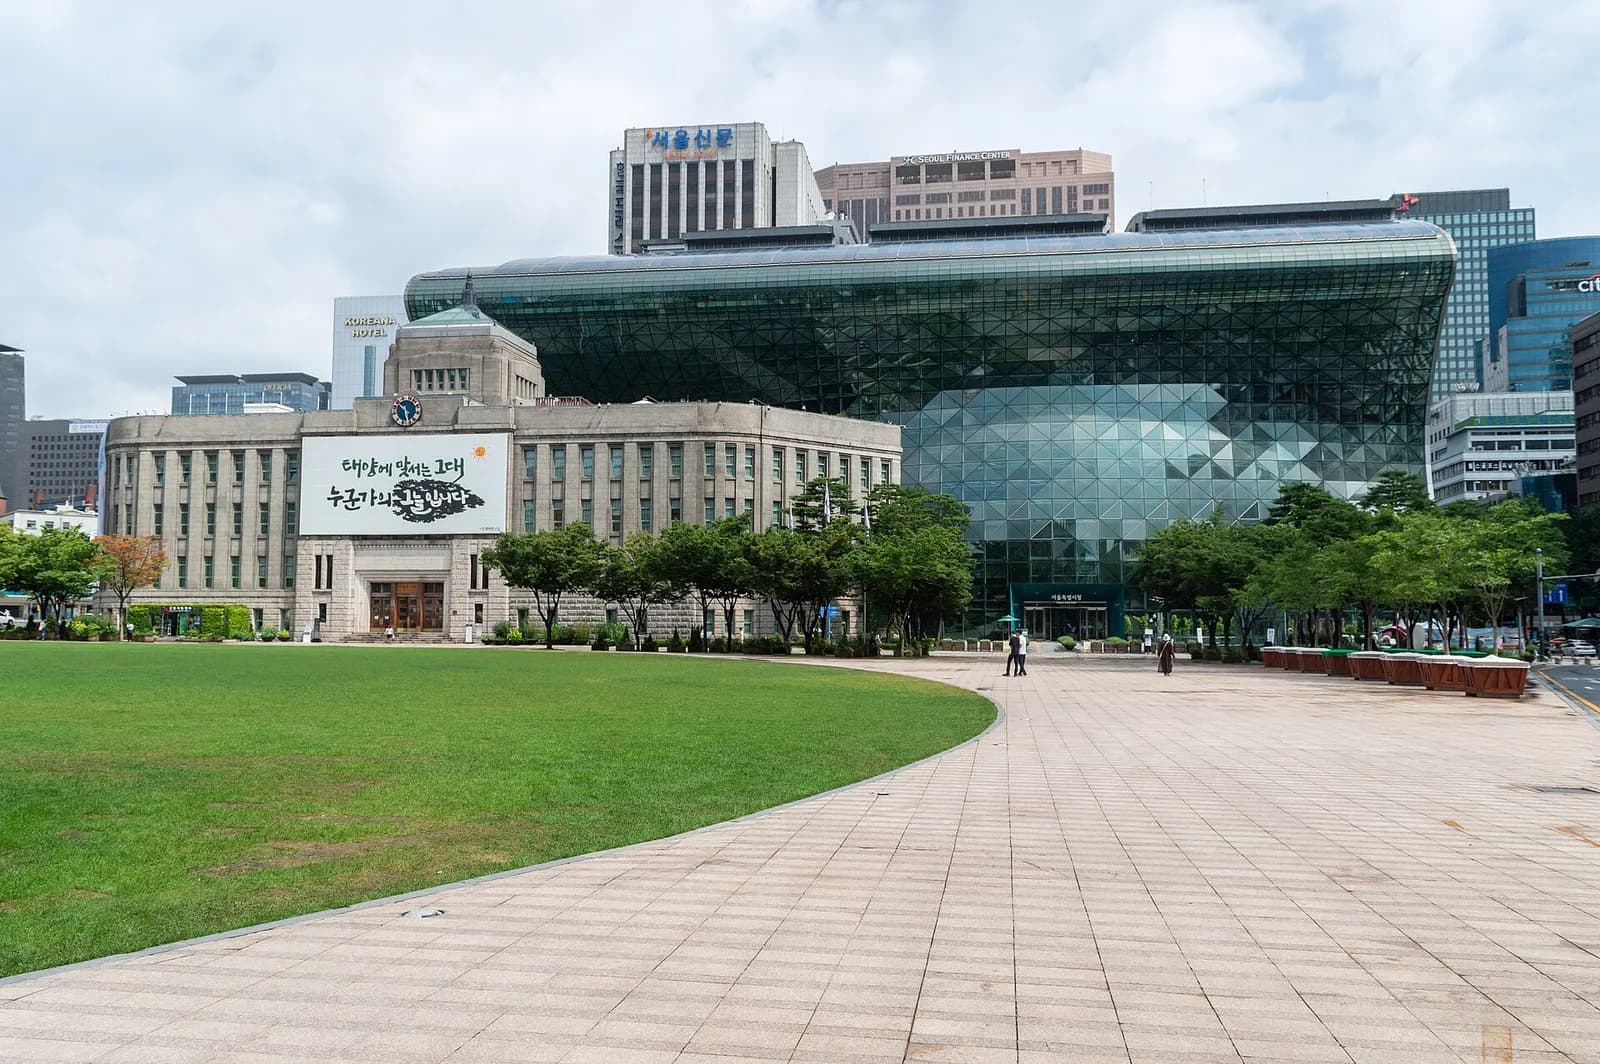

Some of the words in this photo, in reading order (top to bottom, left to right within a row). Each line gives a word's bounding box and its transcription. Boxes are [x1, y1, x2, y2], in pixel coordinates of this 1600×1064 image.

[652, 128, 733, 149] 서울신문
[918, 155, 944, 163] SEOUL
[946, 153, 980, 162] FINANCE
[981, 151, 1010, 160] CENTER
[344, 316, 396, 326] KOREANA
[352, 328, 387, 338] HOTEL
[341, 457, 392, 478] 태양에
[396, 456, 432, 477] 맞서는
[434, 457, 464, 477] 그대
[326, 485, 392, 511] 누군가의
[400, 485, 469, 515] 그늘입니다
